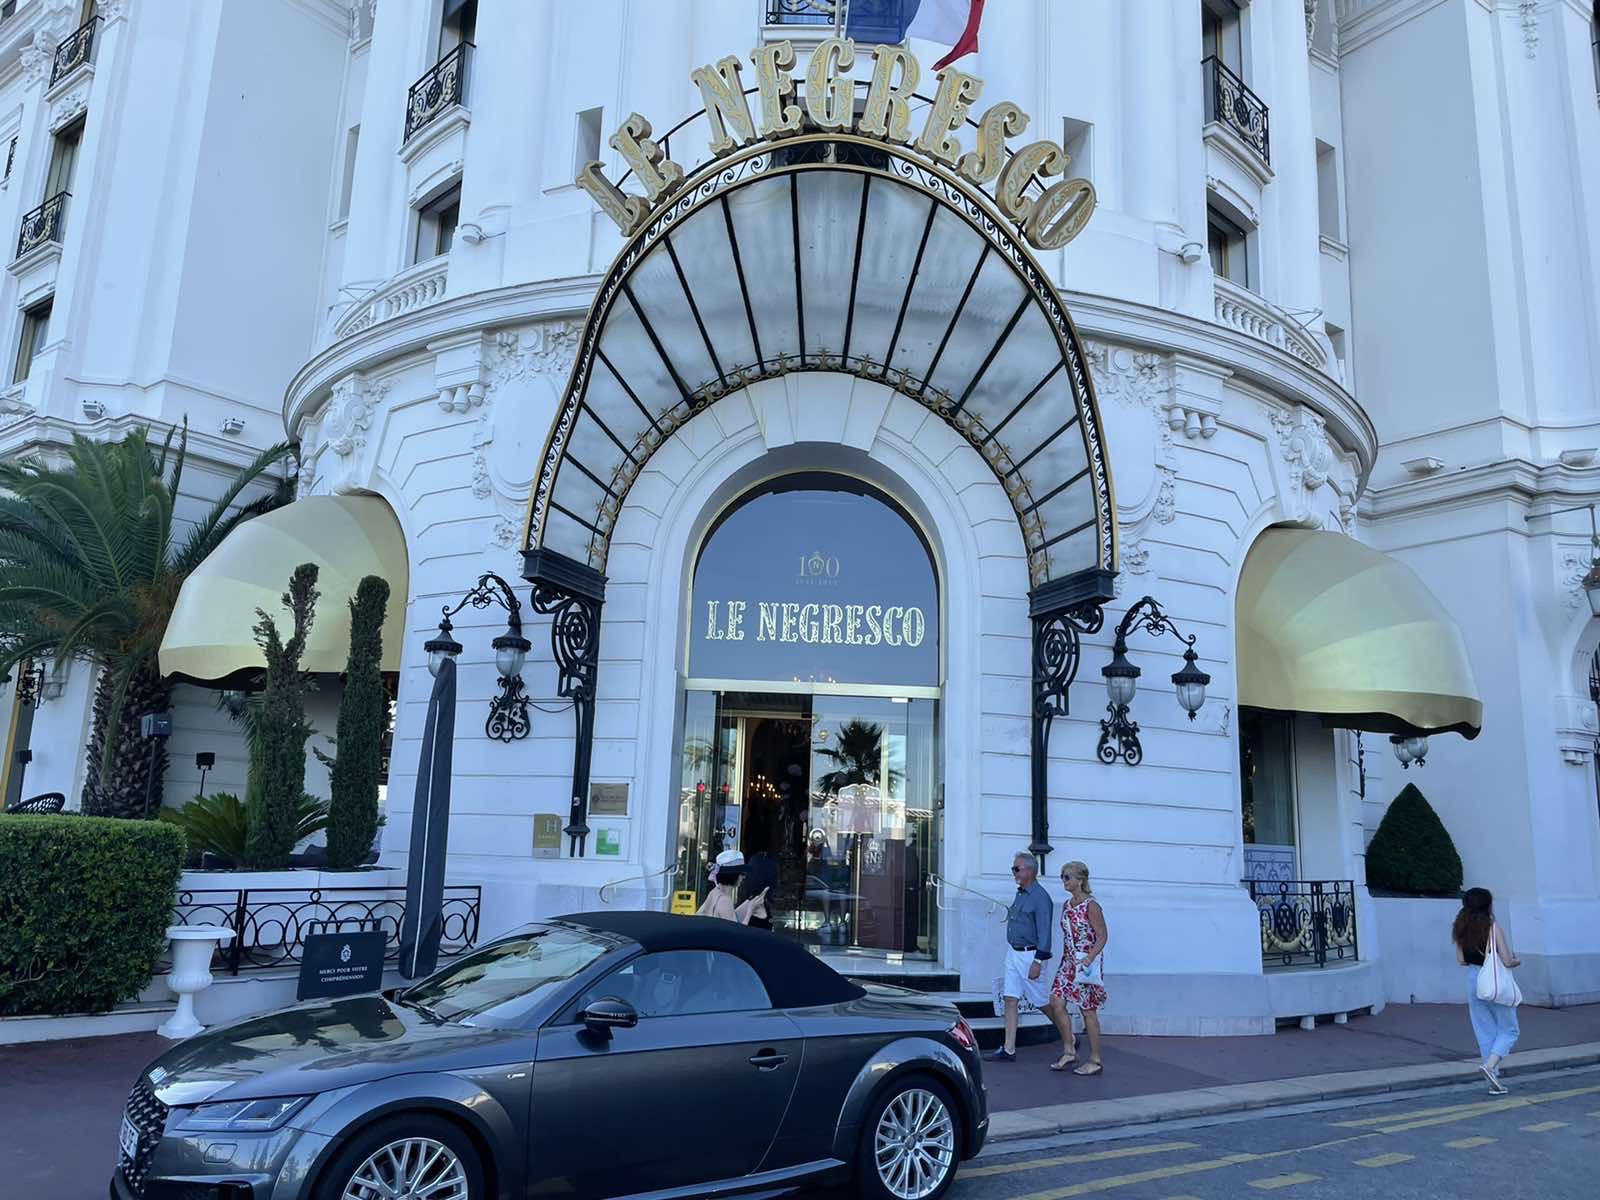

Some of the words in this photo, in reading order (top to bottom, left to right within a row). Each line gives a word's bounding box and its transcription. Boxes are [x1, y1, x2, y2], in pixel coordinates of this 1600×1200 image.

[576, 112, 684, 237] LE
[691, 38, 1097, 250] NEGRESCO
[705, 600, 746, 641] LE
[757, 602, 925, 647] NEGRESCO
